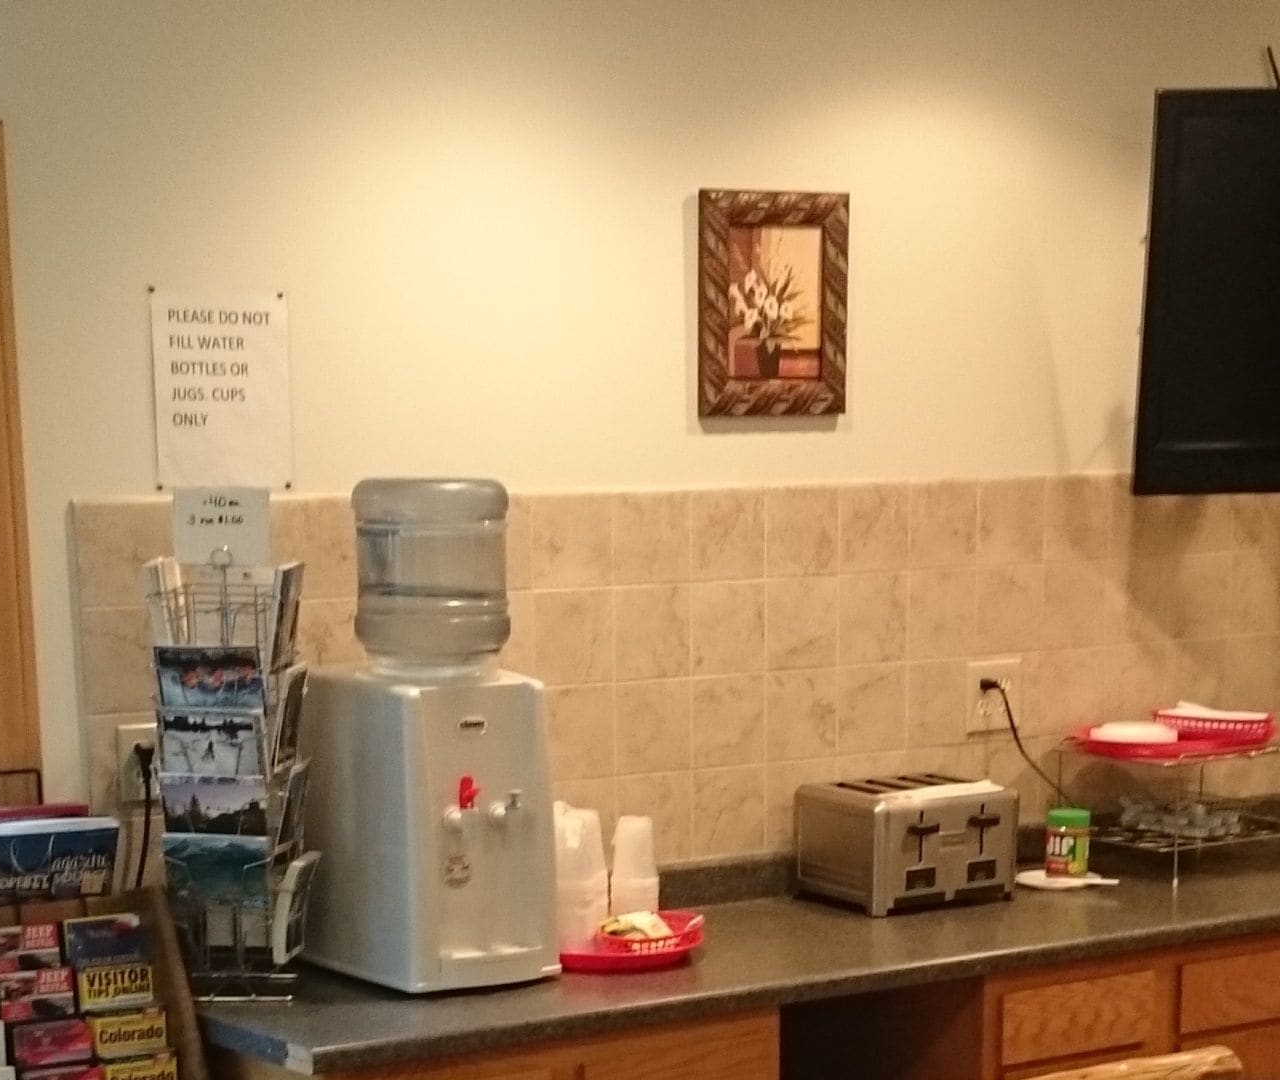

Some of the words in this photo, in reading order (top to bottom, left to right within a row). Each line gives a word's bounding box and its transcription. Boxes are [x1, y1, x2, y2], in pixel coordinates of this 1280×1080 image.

[167, 308, 214, 324] PLEASE
[219, 310, 238, 325] DO
[243, 311, 270, 326] NOT
[169, 335, 193, 349] FILL
[198, 336, 244, 350] WATER
[171, 360, 226, 376] BOTTLES
[230, 362, 249, 376] OR
[212, 387, 246, 402] CUPS
[173, 412, 208, 427] ONLY
[85, 967, 150, 988] VISITOR
[98, 1024, 164, 1045] Colorado
